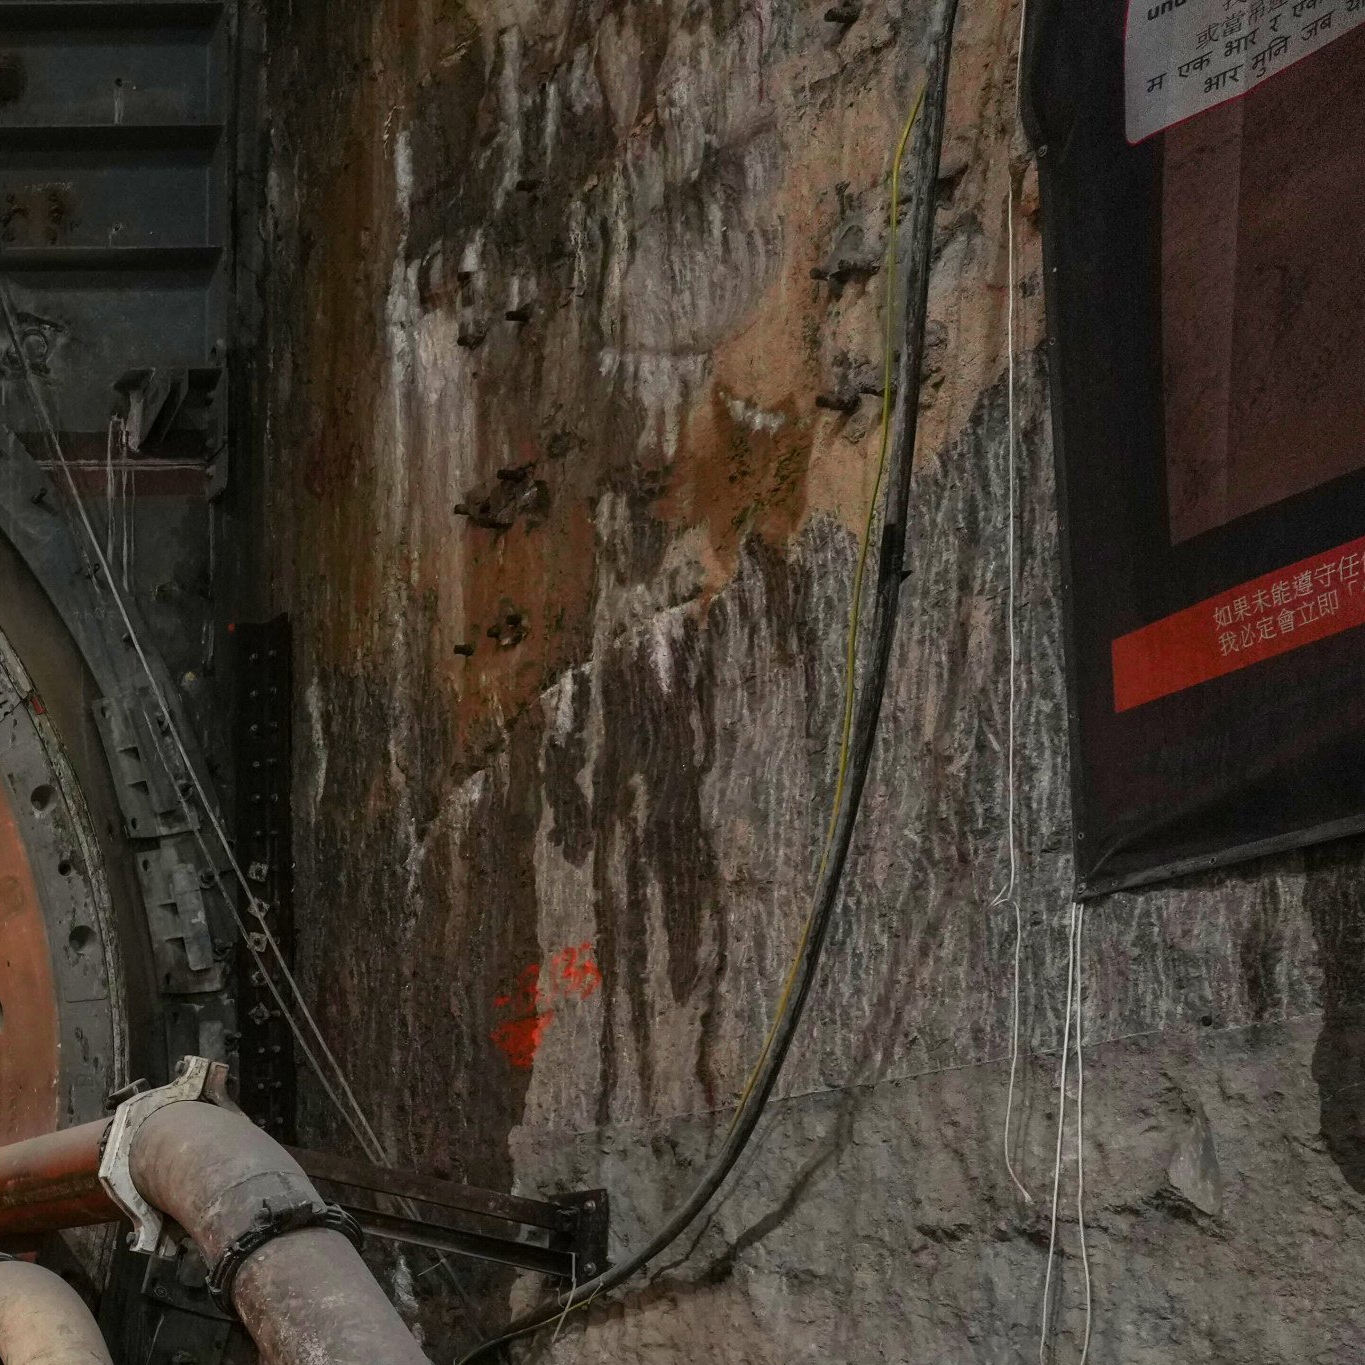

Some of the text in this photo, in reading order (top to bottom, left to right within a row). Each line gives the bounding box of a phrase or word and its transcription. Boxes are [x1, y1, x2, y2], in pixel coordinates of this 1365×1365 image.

[1213, 550, 1365, 632] 如果未能遵守任
